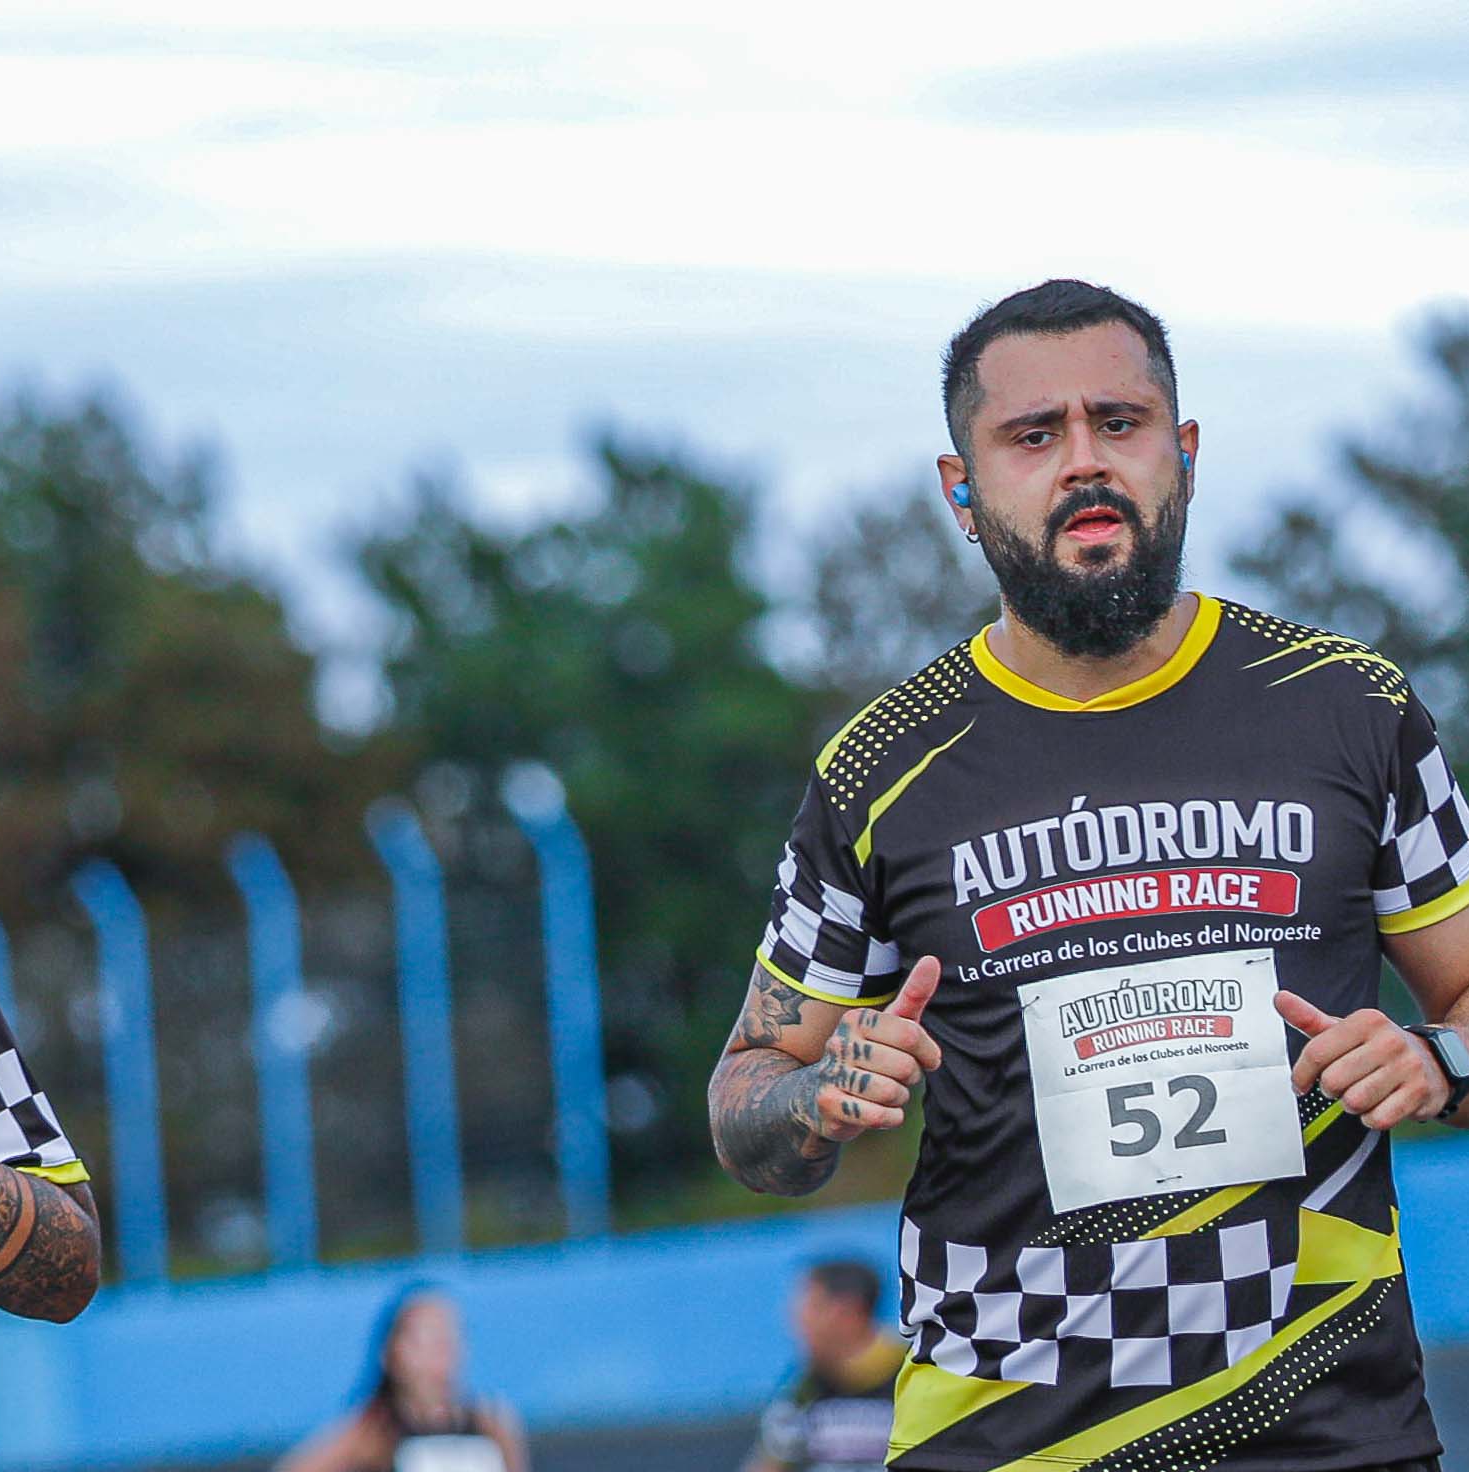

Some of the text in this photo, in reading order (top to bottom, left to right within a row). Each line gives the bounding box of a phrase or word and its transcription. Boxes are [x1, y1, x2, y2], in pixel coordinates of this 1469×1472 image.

[951, 795, 1314, 907] AUTÓDROMO
[1006, 872, 1262, 937] RUNNING RACE
[958, 922, 1321, 983] La Carrera de los Clubes del Noroeste
[1059, 978, 1243, 1038] AUTÓDROMO
[1091, 1018, 1215, 1054] RUNNING RACE
[1064, 1041, 1249, 1077] La Carrera de los Clubes del Noroeste
[1105, 1074, 1228, 1158] 52
